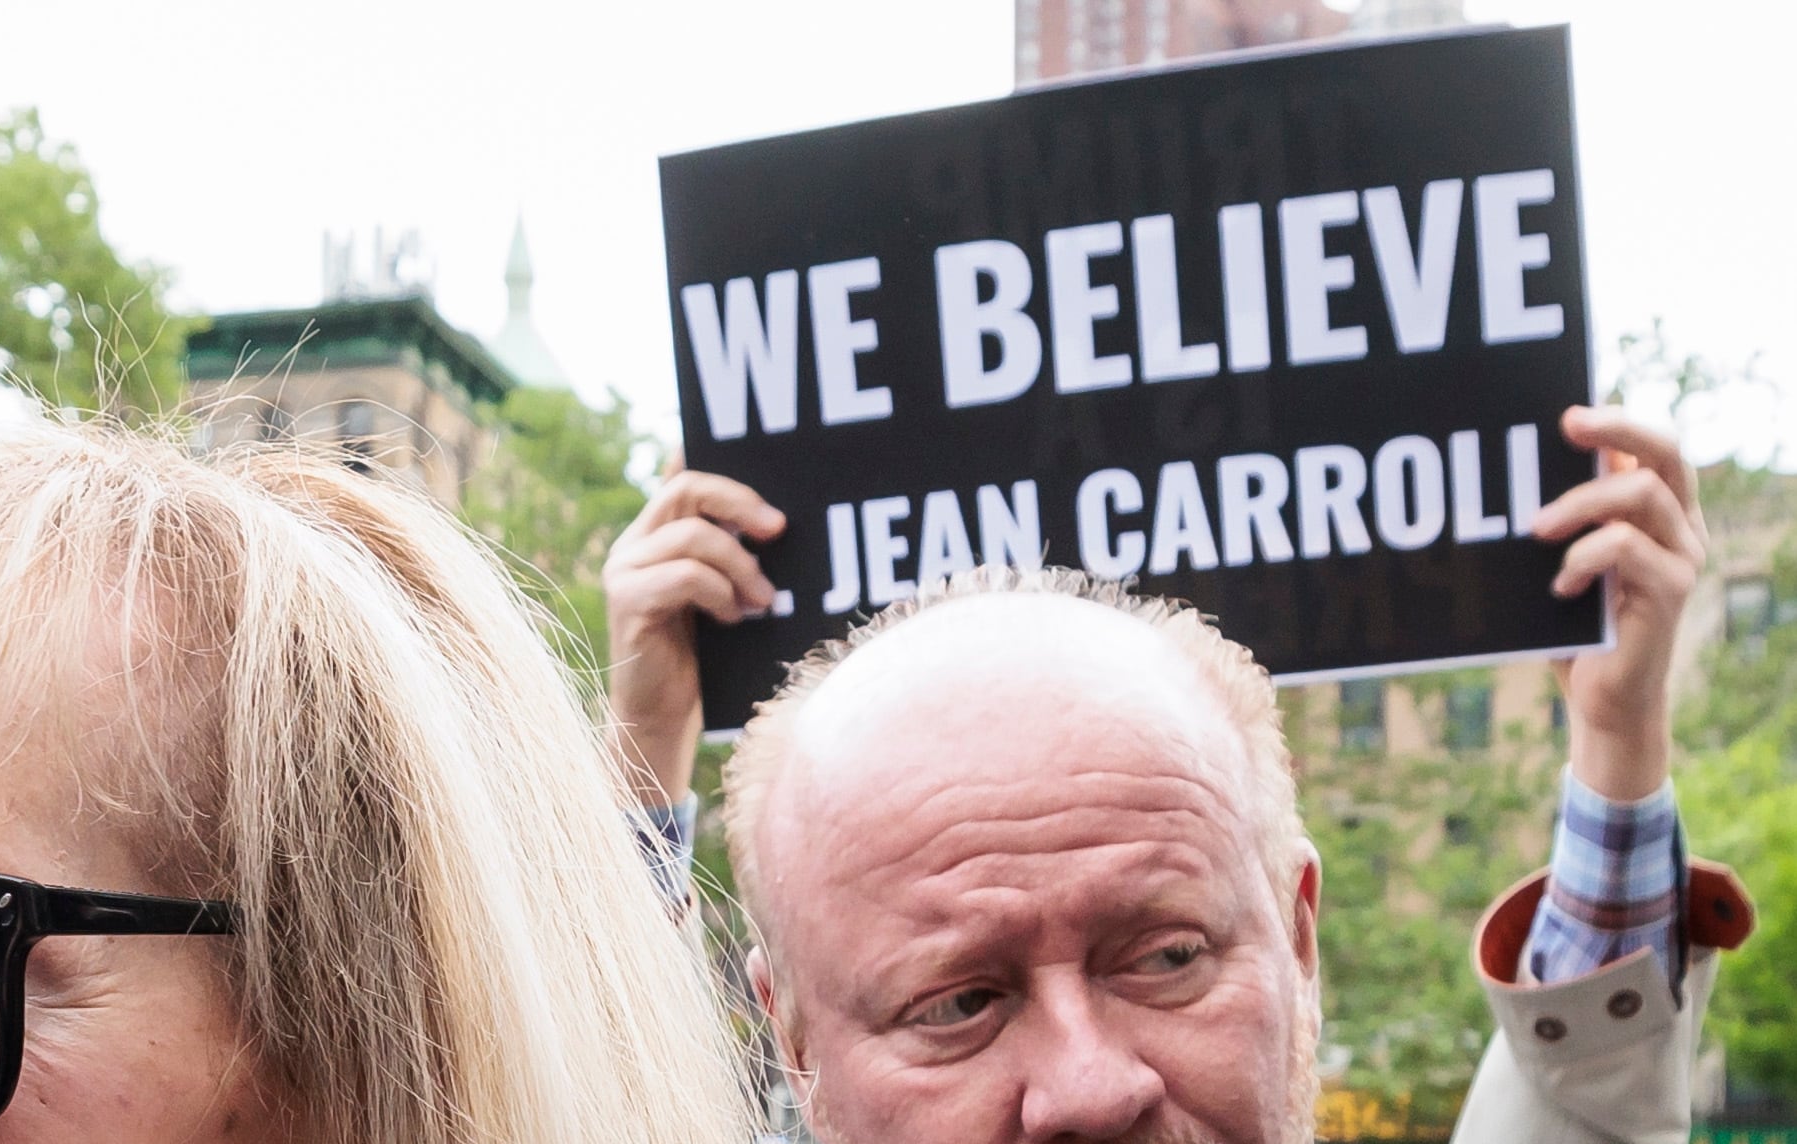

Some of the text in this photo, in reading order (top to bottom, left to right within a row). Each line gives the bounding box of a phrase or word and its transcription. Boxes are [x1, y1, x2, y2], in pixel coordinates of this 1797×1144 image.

[681, 256, 894, 441] WE
[934, 168, 1566, 410] BELIEVE
[822, 478, 1042, 615] JEAN
